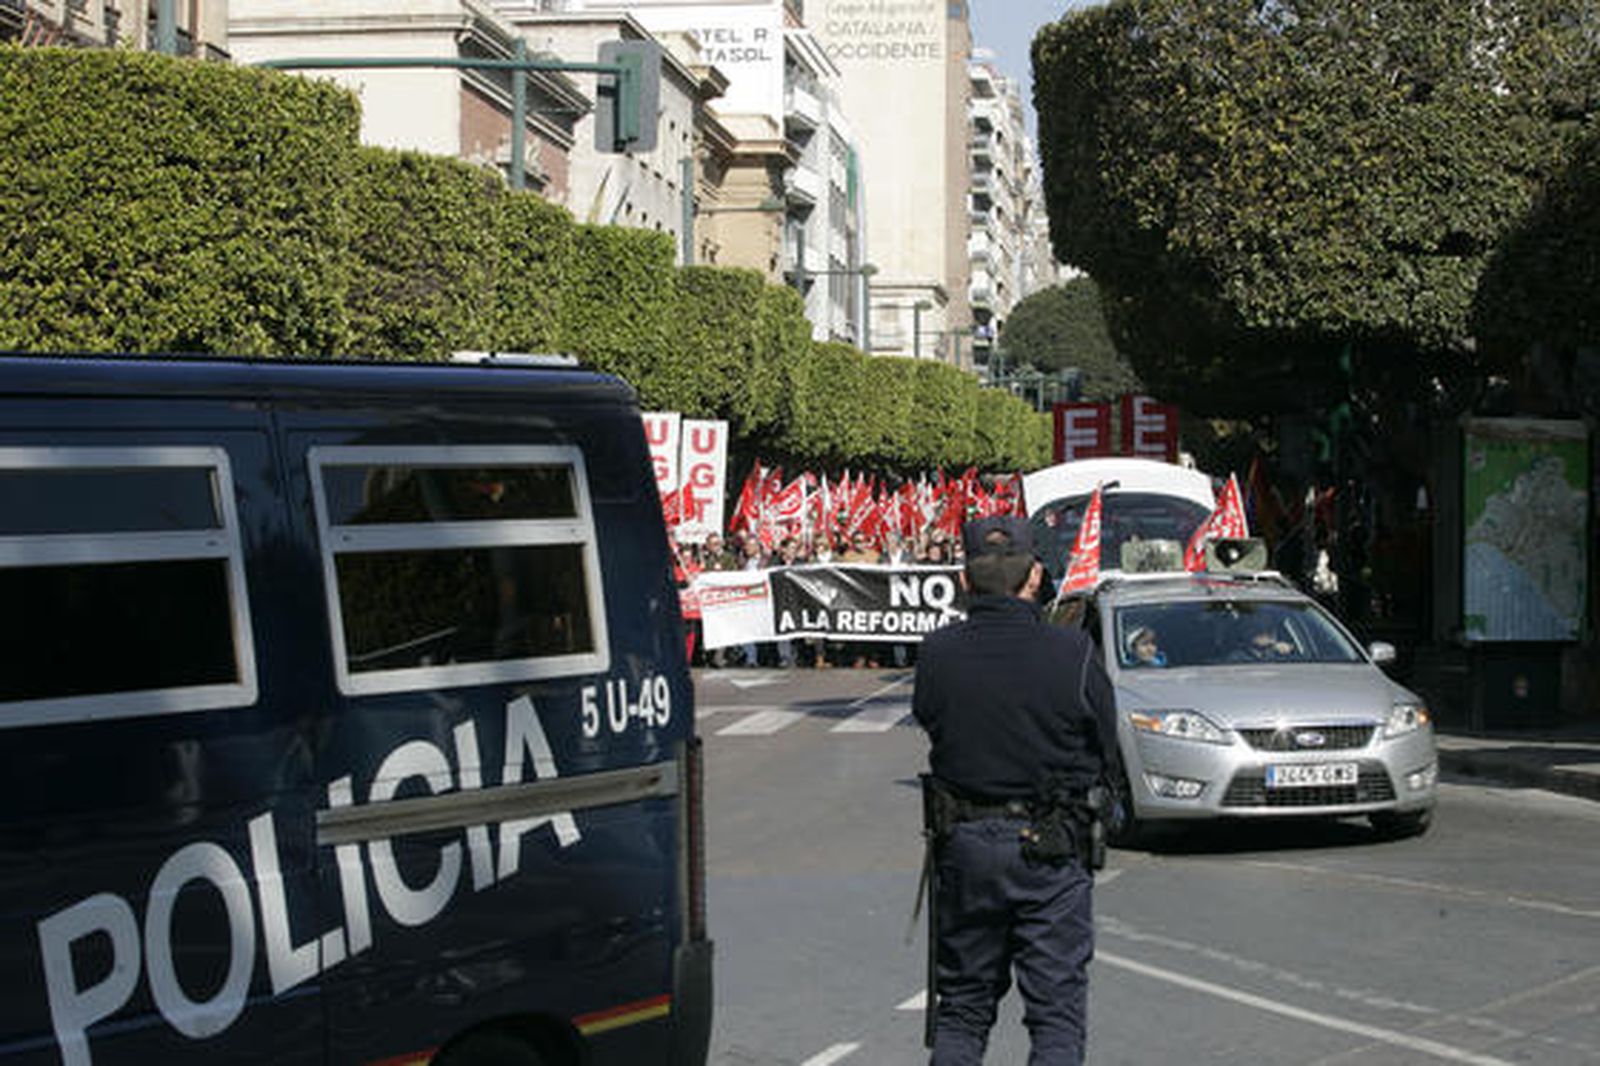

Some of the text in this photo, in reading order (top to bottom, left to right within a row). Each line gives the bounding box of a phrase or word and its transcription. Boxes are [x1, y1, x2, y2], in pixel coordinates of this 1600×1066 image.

[826, 42, 942, 59] OCCIDENTE
[889, 574, 956, 608] NO
[779, 610, 796, 632] A
[801, 609, 831, 630] LA
[581, 674, 671, 738] 5 U-49
[36, 693, 581, 1066] POLICIA
